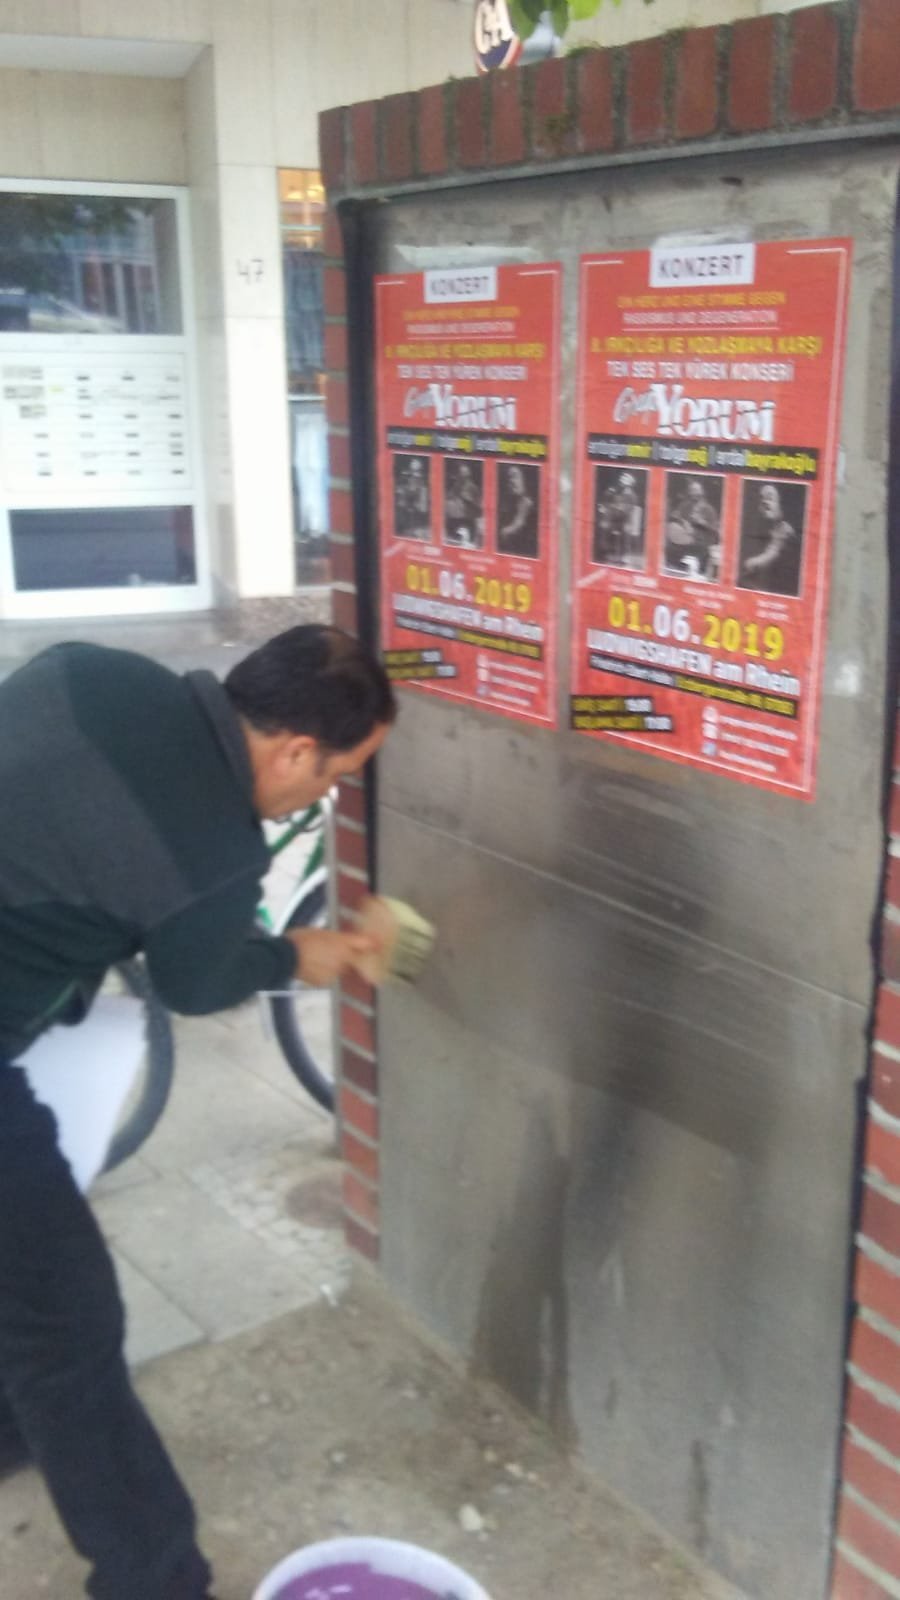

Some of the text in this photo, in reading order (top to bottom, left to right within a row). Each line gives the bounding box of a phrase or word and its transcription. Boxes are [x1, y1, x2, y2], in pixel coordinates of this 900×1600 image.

[236, 258, 264, 285] 47
[657, 253, 744, 280] KONZERT
[406, 564, 531, 614] 01.06.2019
[607, 595, 785, 661] 01.06.2019
[713, 660, 743, 683] am
[745, 661, 800, 696] Rhein
